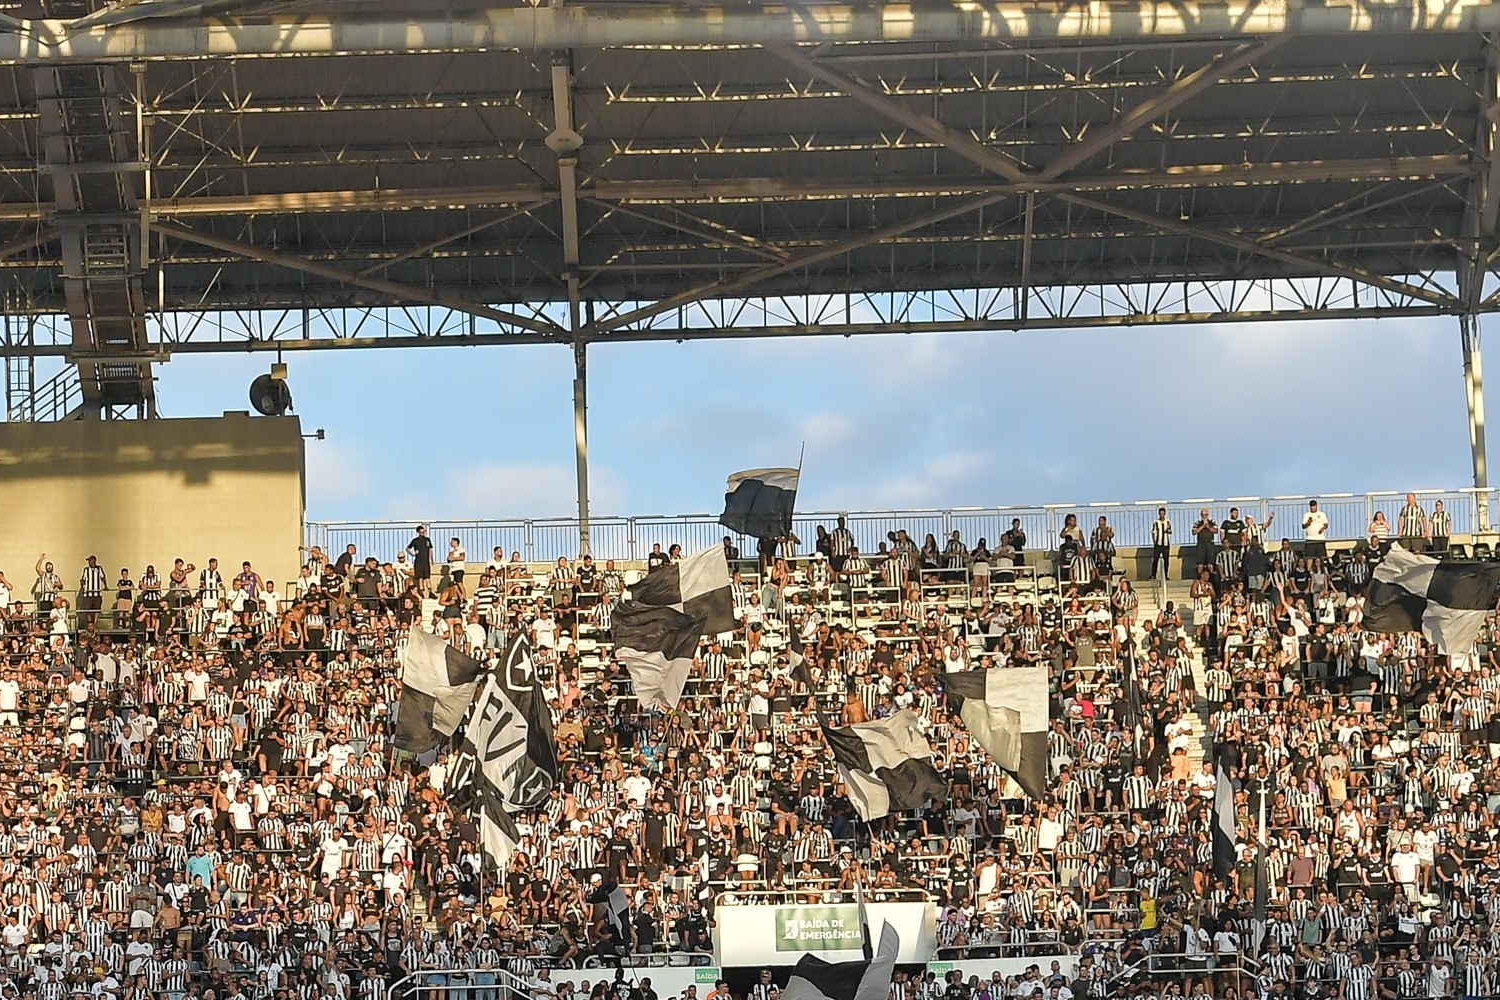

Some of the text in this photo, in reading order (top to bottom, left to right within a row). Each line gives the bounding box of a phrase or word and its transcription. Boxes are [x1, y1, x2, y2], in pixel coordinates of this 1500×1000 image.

[800, 919, 845, 929] SAÍDA DE
[800, 929, 862, 941] EMERGÊNCIA
[696, 972, 718, 980] SAÍDA
